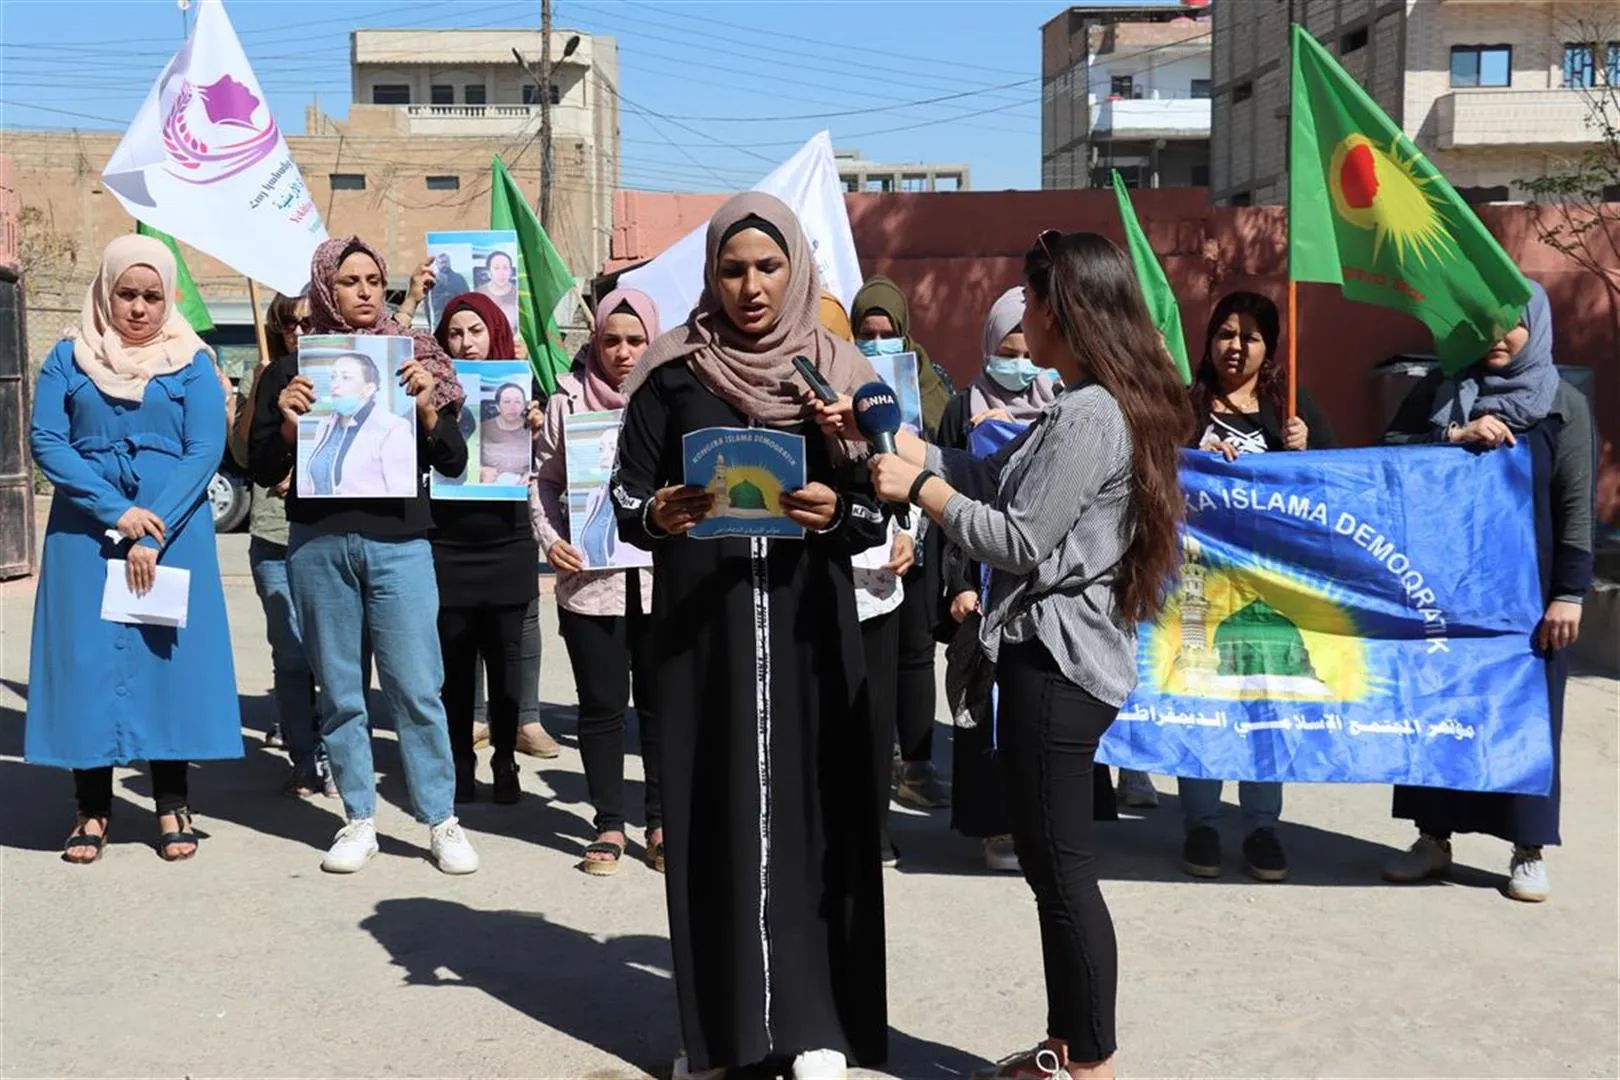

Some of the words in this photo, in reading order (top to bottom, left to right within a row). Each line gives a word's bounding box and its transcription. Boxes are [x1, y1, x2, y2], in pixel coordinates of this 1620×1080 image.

[1221, 488, 1328, 526] ISLAMA
[1335, 512, 1449, 655] DEMOQRATIK
[1115, 703, 1228, 728] الديمقراط
[1427, 718, 1475, 740] مؤتمر
